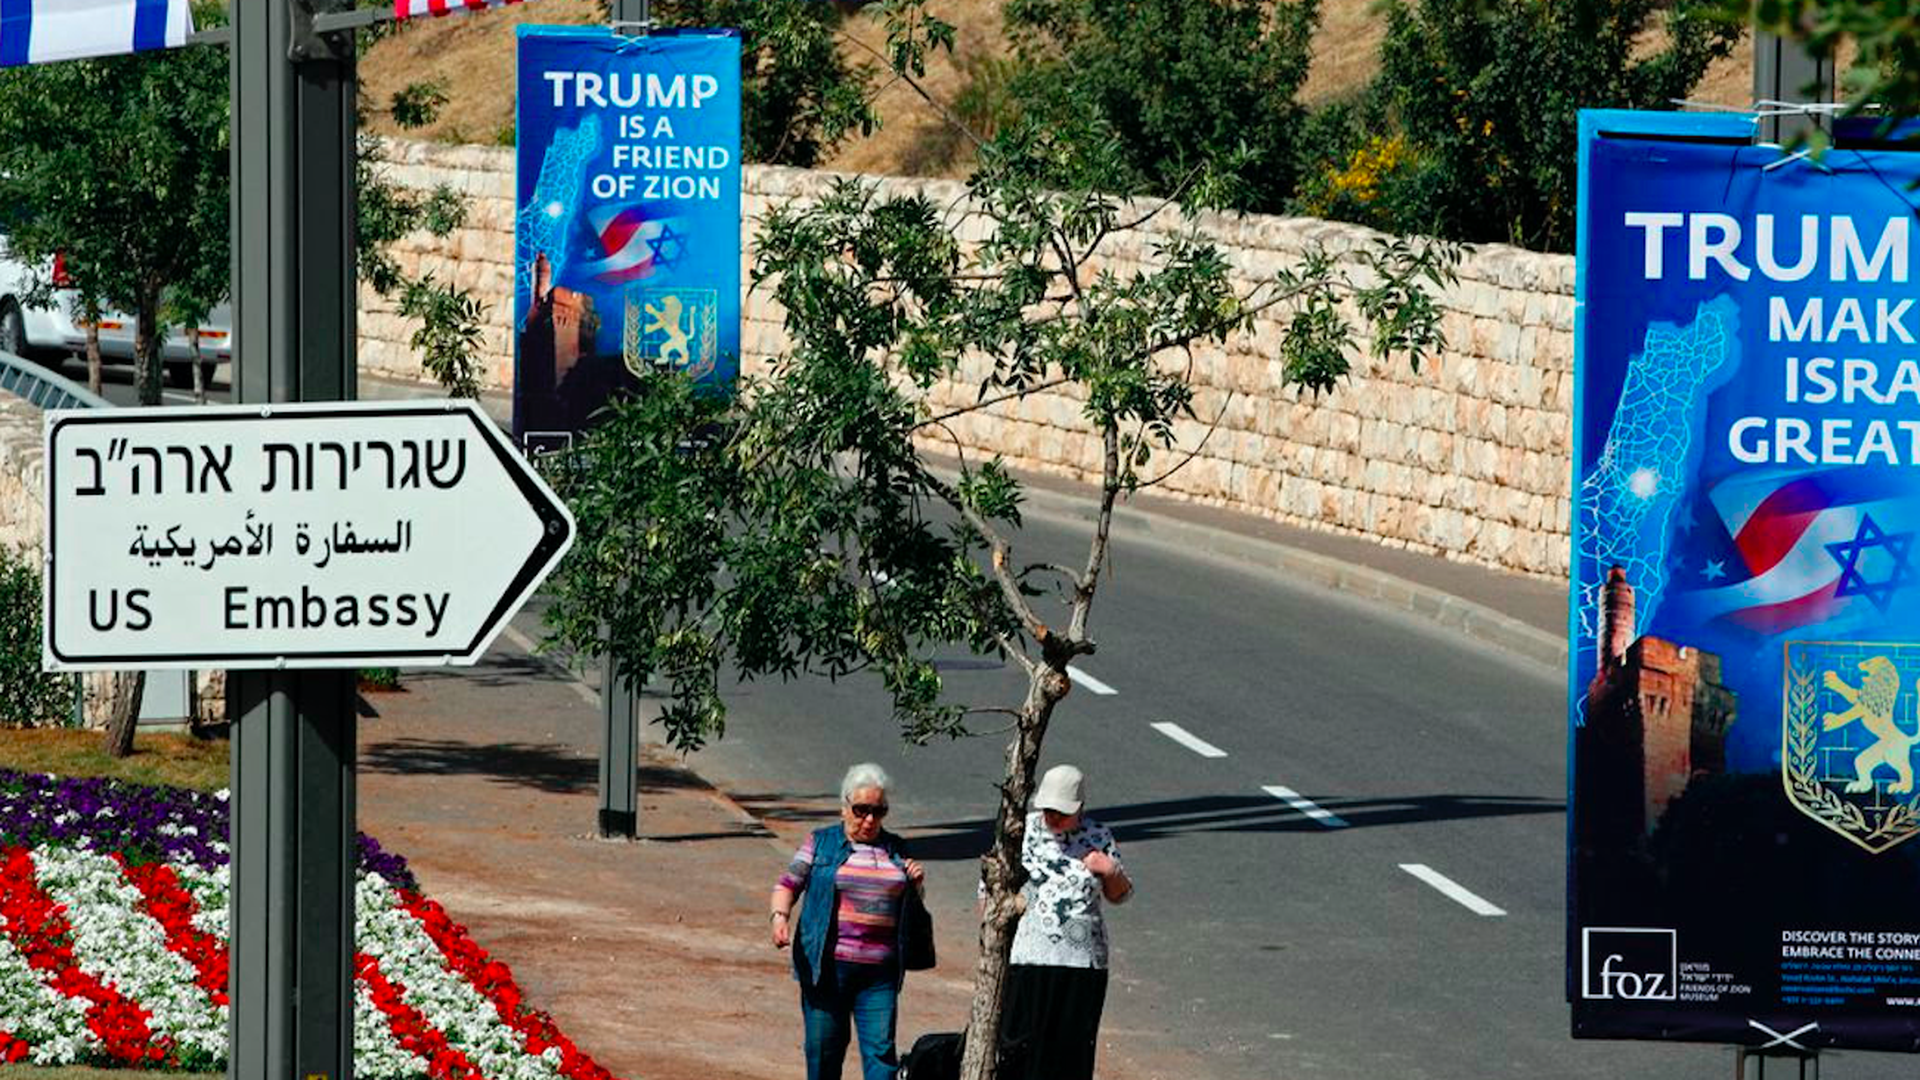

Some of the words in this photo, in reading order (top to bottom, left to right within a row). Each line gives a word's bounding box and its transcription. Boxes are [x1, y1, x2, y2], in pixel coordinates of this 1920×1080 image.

[544, 71, 718, 107] TRUMP
[620, 115, 646, 138] IS
[653, 115, 674, 138] A
[613, 145, 729, 169] FRIEND
[592, 174, 635, 199] OF
[643, 175, 720, 199] ZION
[261, 439, 466, 492] שגרירות
[128, 509, 274, 571] الأمريكية
[296, 518, 411, 569] السفارة
[89, 589, 153, 632] US
[224, 585, 450, 637] Embassy
[1782, 930, 1847, 943] DISCOVER
[1849, 931, 1875, 944] THE
[1782, 945, 1844, 959] EMBRACE
[1847, 946, 1872, 960] THE
[1600, 954, 1668, 999] foz
